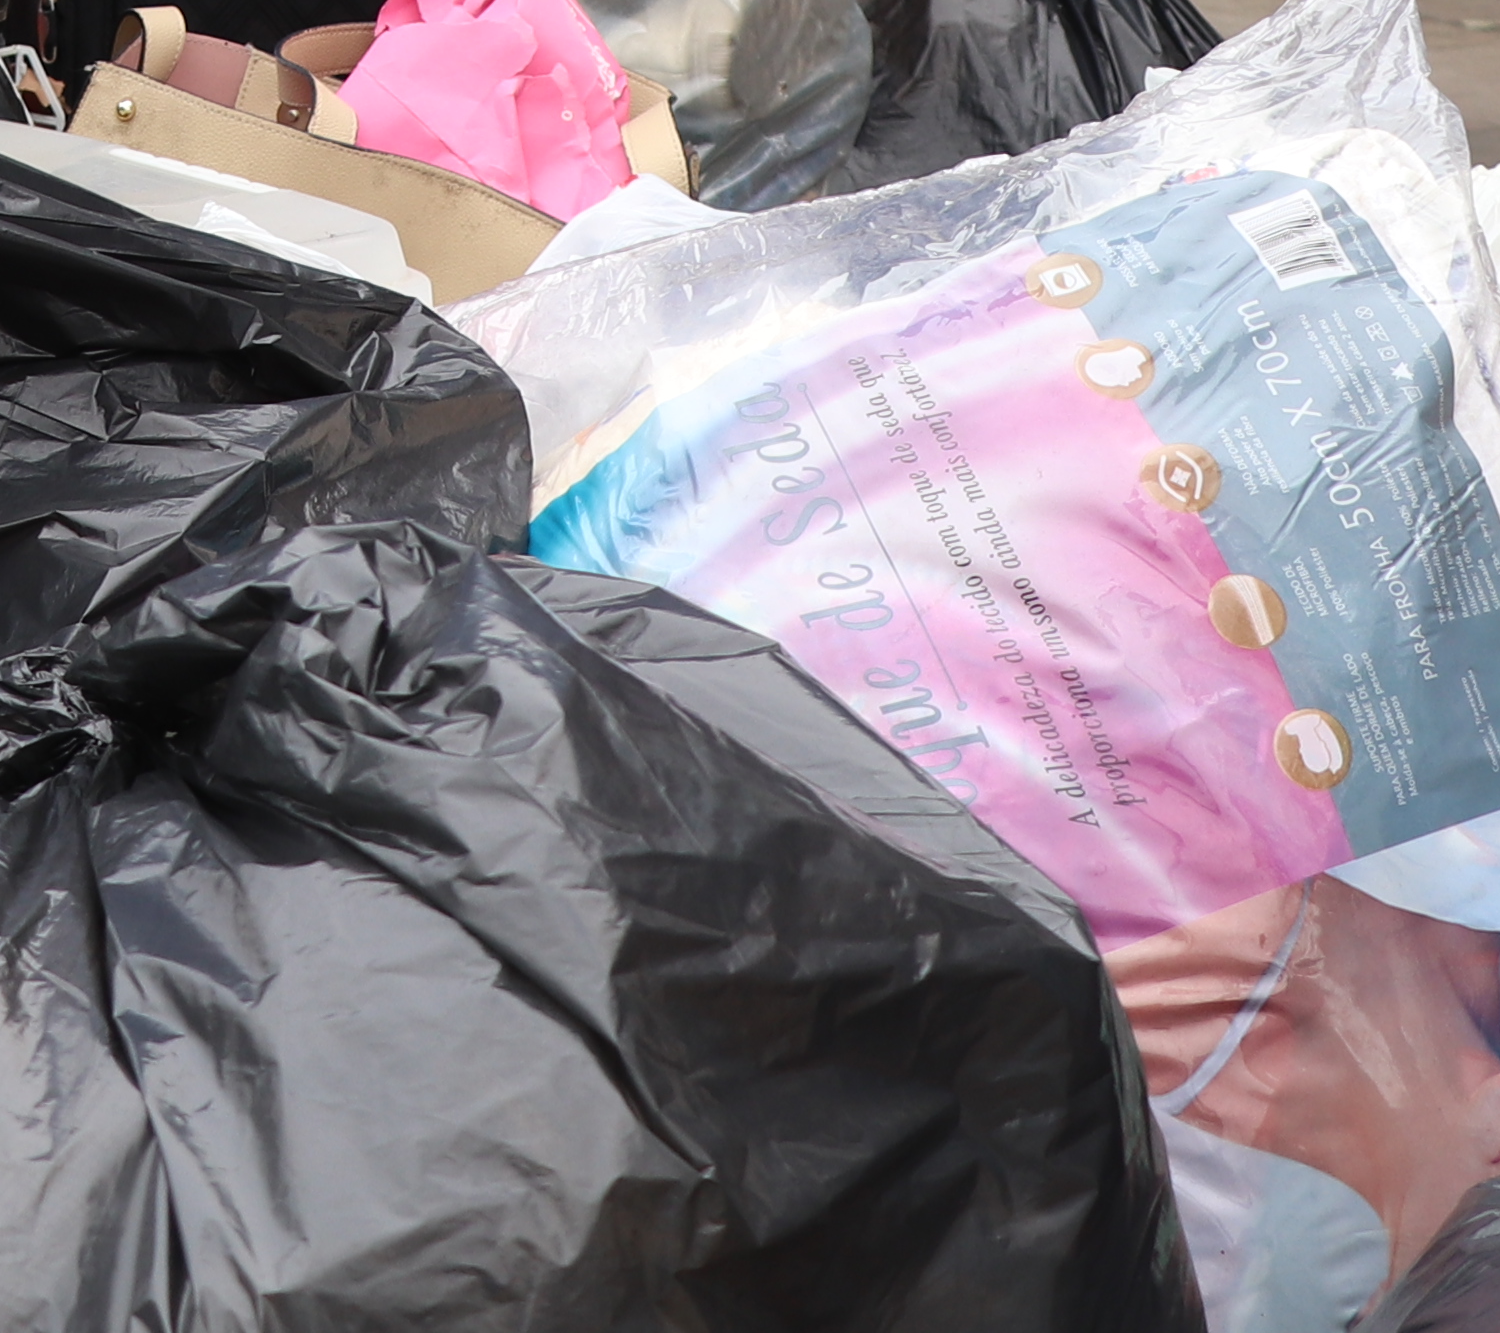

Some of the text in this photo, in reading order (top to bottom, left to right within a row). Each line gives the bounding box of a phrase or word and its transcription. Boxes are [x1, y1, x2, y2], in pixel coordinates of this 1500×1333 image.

[1145, 260, 1160, 275] EM
[1298, 313, 1312, 329] seu
[1307, 330, 1319, 342] do
[1318, 318, 1330, 334] seu
[1189, 352, 1203, 373] Sem
[1318, 349, 1337, 374] saúde
[1327, 334, 1353, 370] trocando
[1348, 340, 1363, 360] cada
[1333, 374, 1346, 390] sua
[1342, 390, 1353, 402] da
[1363, 368, 1393, 415] travesseiro
[1349, 404, 1365, 428] Cuide
[721, 382, 848, 542] Seda
[1217, 427, 1259, 495] NÃO DEFORMA
[1233, 427, 1272, 486] Alto poder de
[1240, 415, 1290, 494] resiliência da fibra
[1237, 299, 1438, 681] PARA FRONHA 50cm X 70cm
[1413, 456, 1436, 500] Poliéster
[1398, 504, 1416, 531] 100%
[799, 563, 892, 632] de
[847, 356, 1100, 827] A delicadeza do tecido com toque de seda que
[879, 347, 1147, 807] proporciona um sono ainda mais confortável.
[1282, 564, 1315, 617] TECIDO DE
[1293, 555, 1329, 617] MICROFIBRA
[1309, 547, 1349, 616] 100% Poliéster
[1453, 577, 1470, 618] Recheio:
[1455, 555, 1480, 616] Siliconizada
[1472, 572, 1491, 613] Relleno:
[1433, 590, 1447, 624] Tecido:
[1360, 651, 1385, 695] pescoço
[1379, 696, 1399, 737] cabeça,
[1390, 695, 1411, 736] ombros
[1461, 676, 1481, 725] Travesseiro
[1342, 653, 1407, 806] PARA QUEM DORME DE LADO
[1345, 691, 1385, 773] SUPORTE FIRME
[1397, 748, 1419, 797] Molda-se
